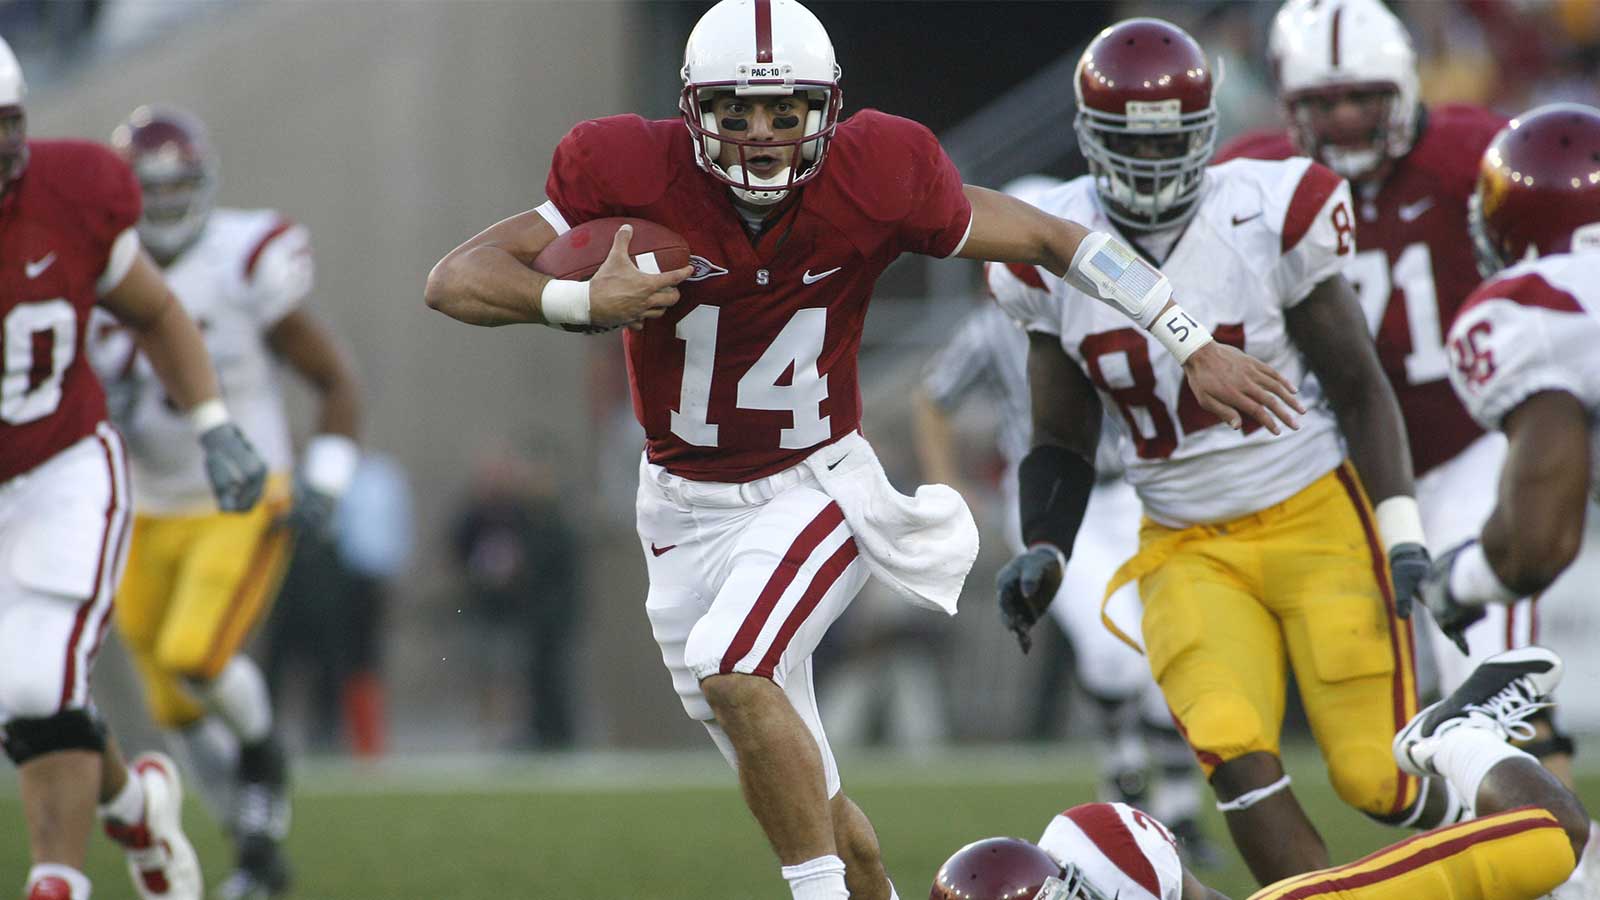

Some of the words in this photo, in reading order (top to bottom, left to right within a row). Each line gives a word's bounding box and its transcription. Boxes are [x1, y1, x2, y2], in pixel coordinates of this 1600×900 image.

[751, 68, 780, 77] PAC-10
[756, 269, 770, 285] S
[1166, 312, 1198, 342] 51
[670, 304, 831, 450] 14
